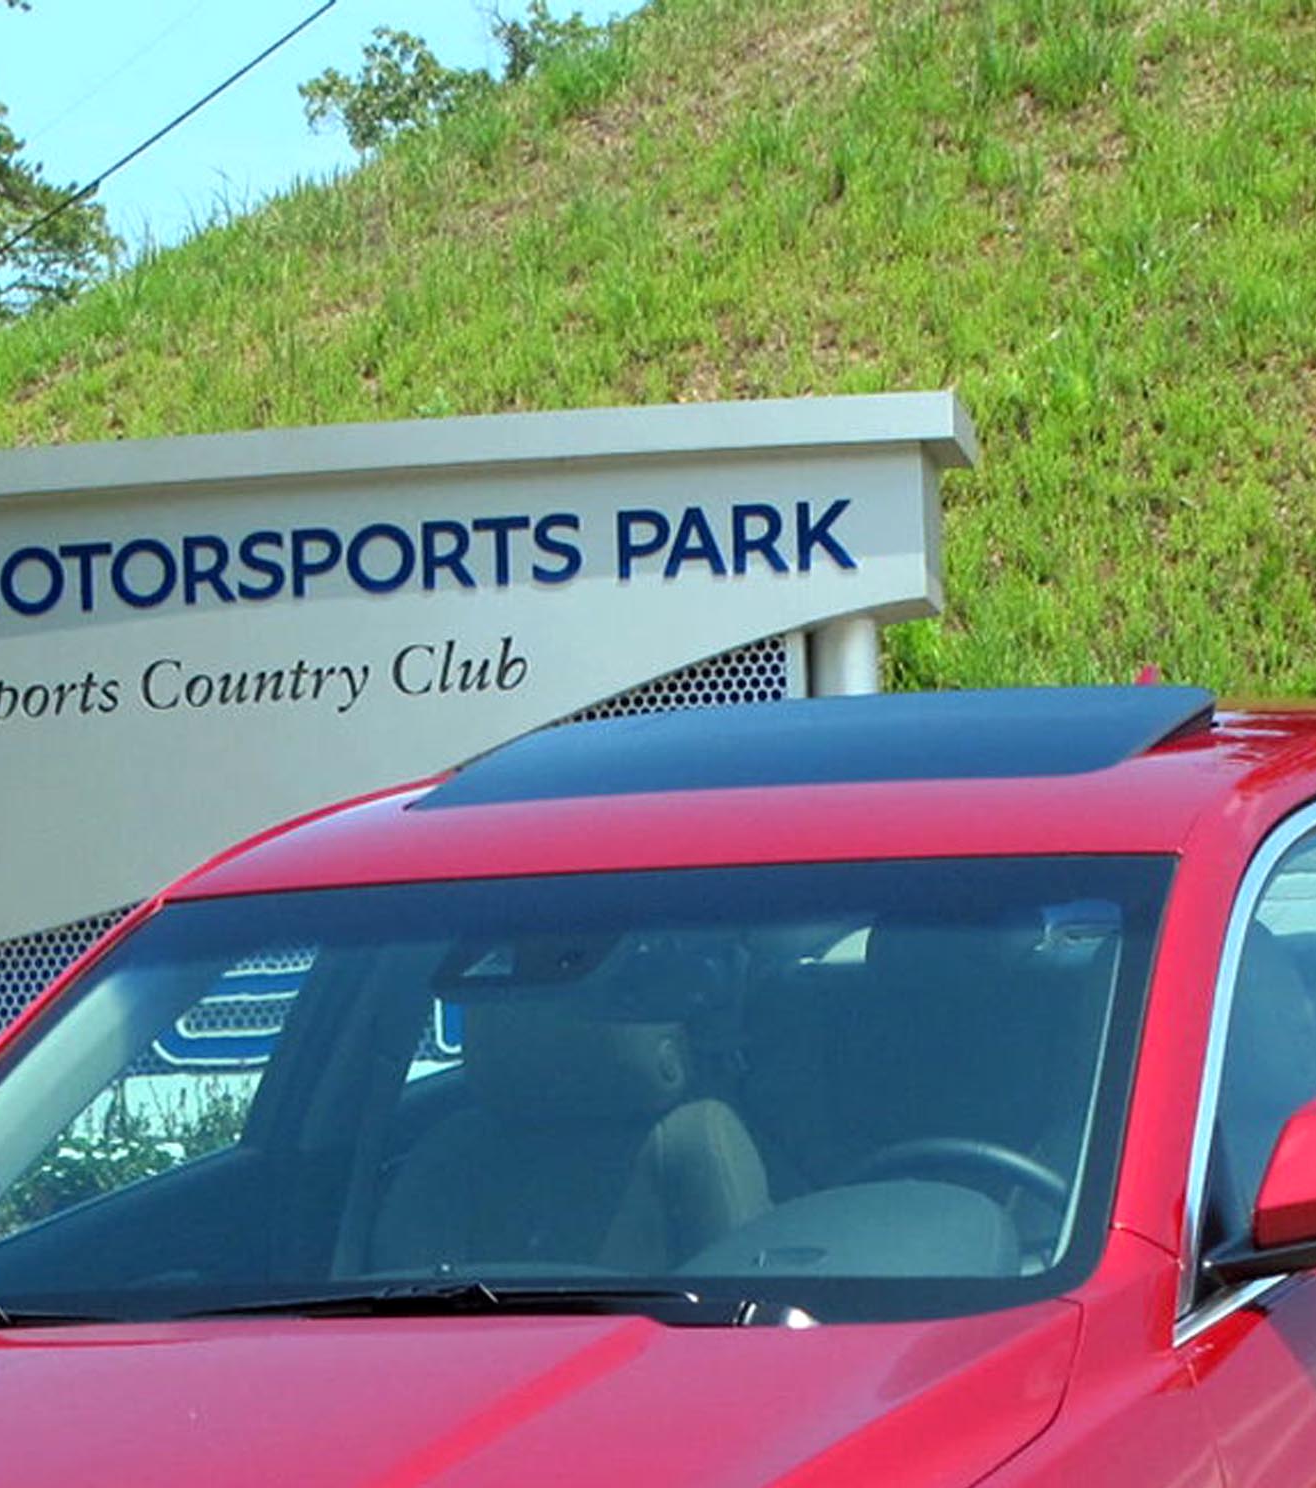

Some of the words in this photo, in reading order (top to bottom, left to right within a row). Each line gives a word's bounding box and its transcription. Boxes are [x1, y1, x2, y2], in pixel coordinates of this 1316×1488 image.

[615, 498, 858, 584] PARK
[140, 658, 371, 714] Country
[391, 635, 530, 697] Club
